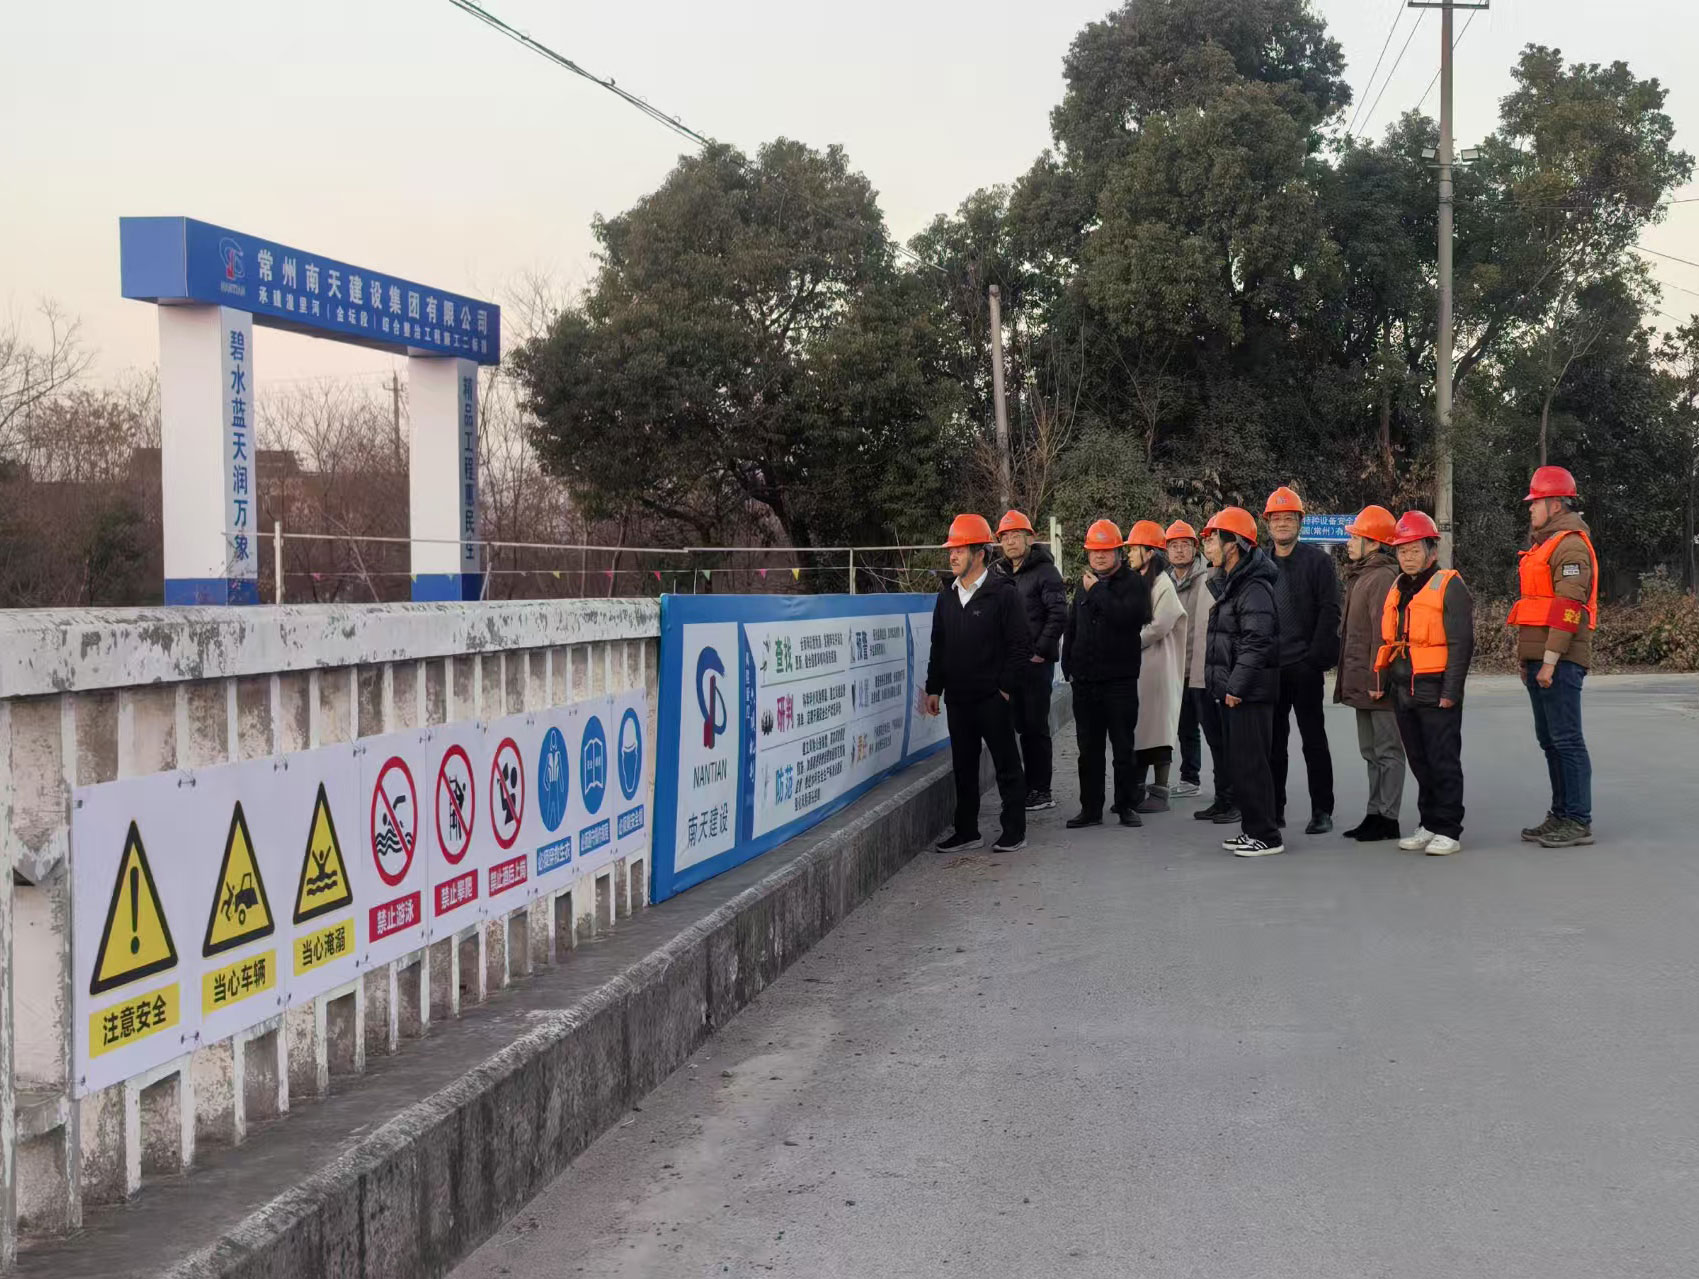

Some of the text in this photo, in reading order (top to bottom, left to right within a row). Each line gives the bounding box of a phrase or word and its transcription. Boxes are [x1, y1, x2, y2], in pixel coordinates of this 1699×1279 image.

[257, 249, 488, 335] 常州南天建设集团有限公司
[229, 330, 250, 560] 碧水蓝天润万象
[774, 635, 793, 674] 查找
[776, 693, 794, 732] 研判
[693, 758, 728, 789] NANTIAN
[775, 764, 794, 806] 防范
[687, 804, 729, 849] 南天建设
[490, 857, 527, 893] 禁止酒后上岗
[376, 899, 415, 934] 禁止游泳
[302, 926, 346, 967] 当心淹溺
[213, 957, 266, 1004] 当心车辆
[102, 994, 168, 1047] 注意安全
